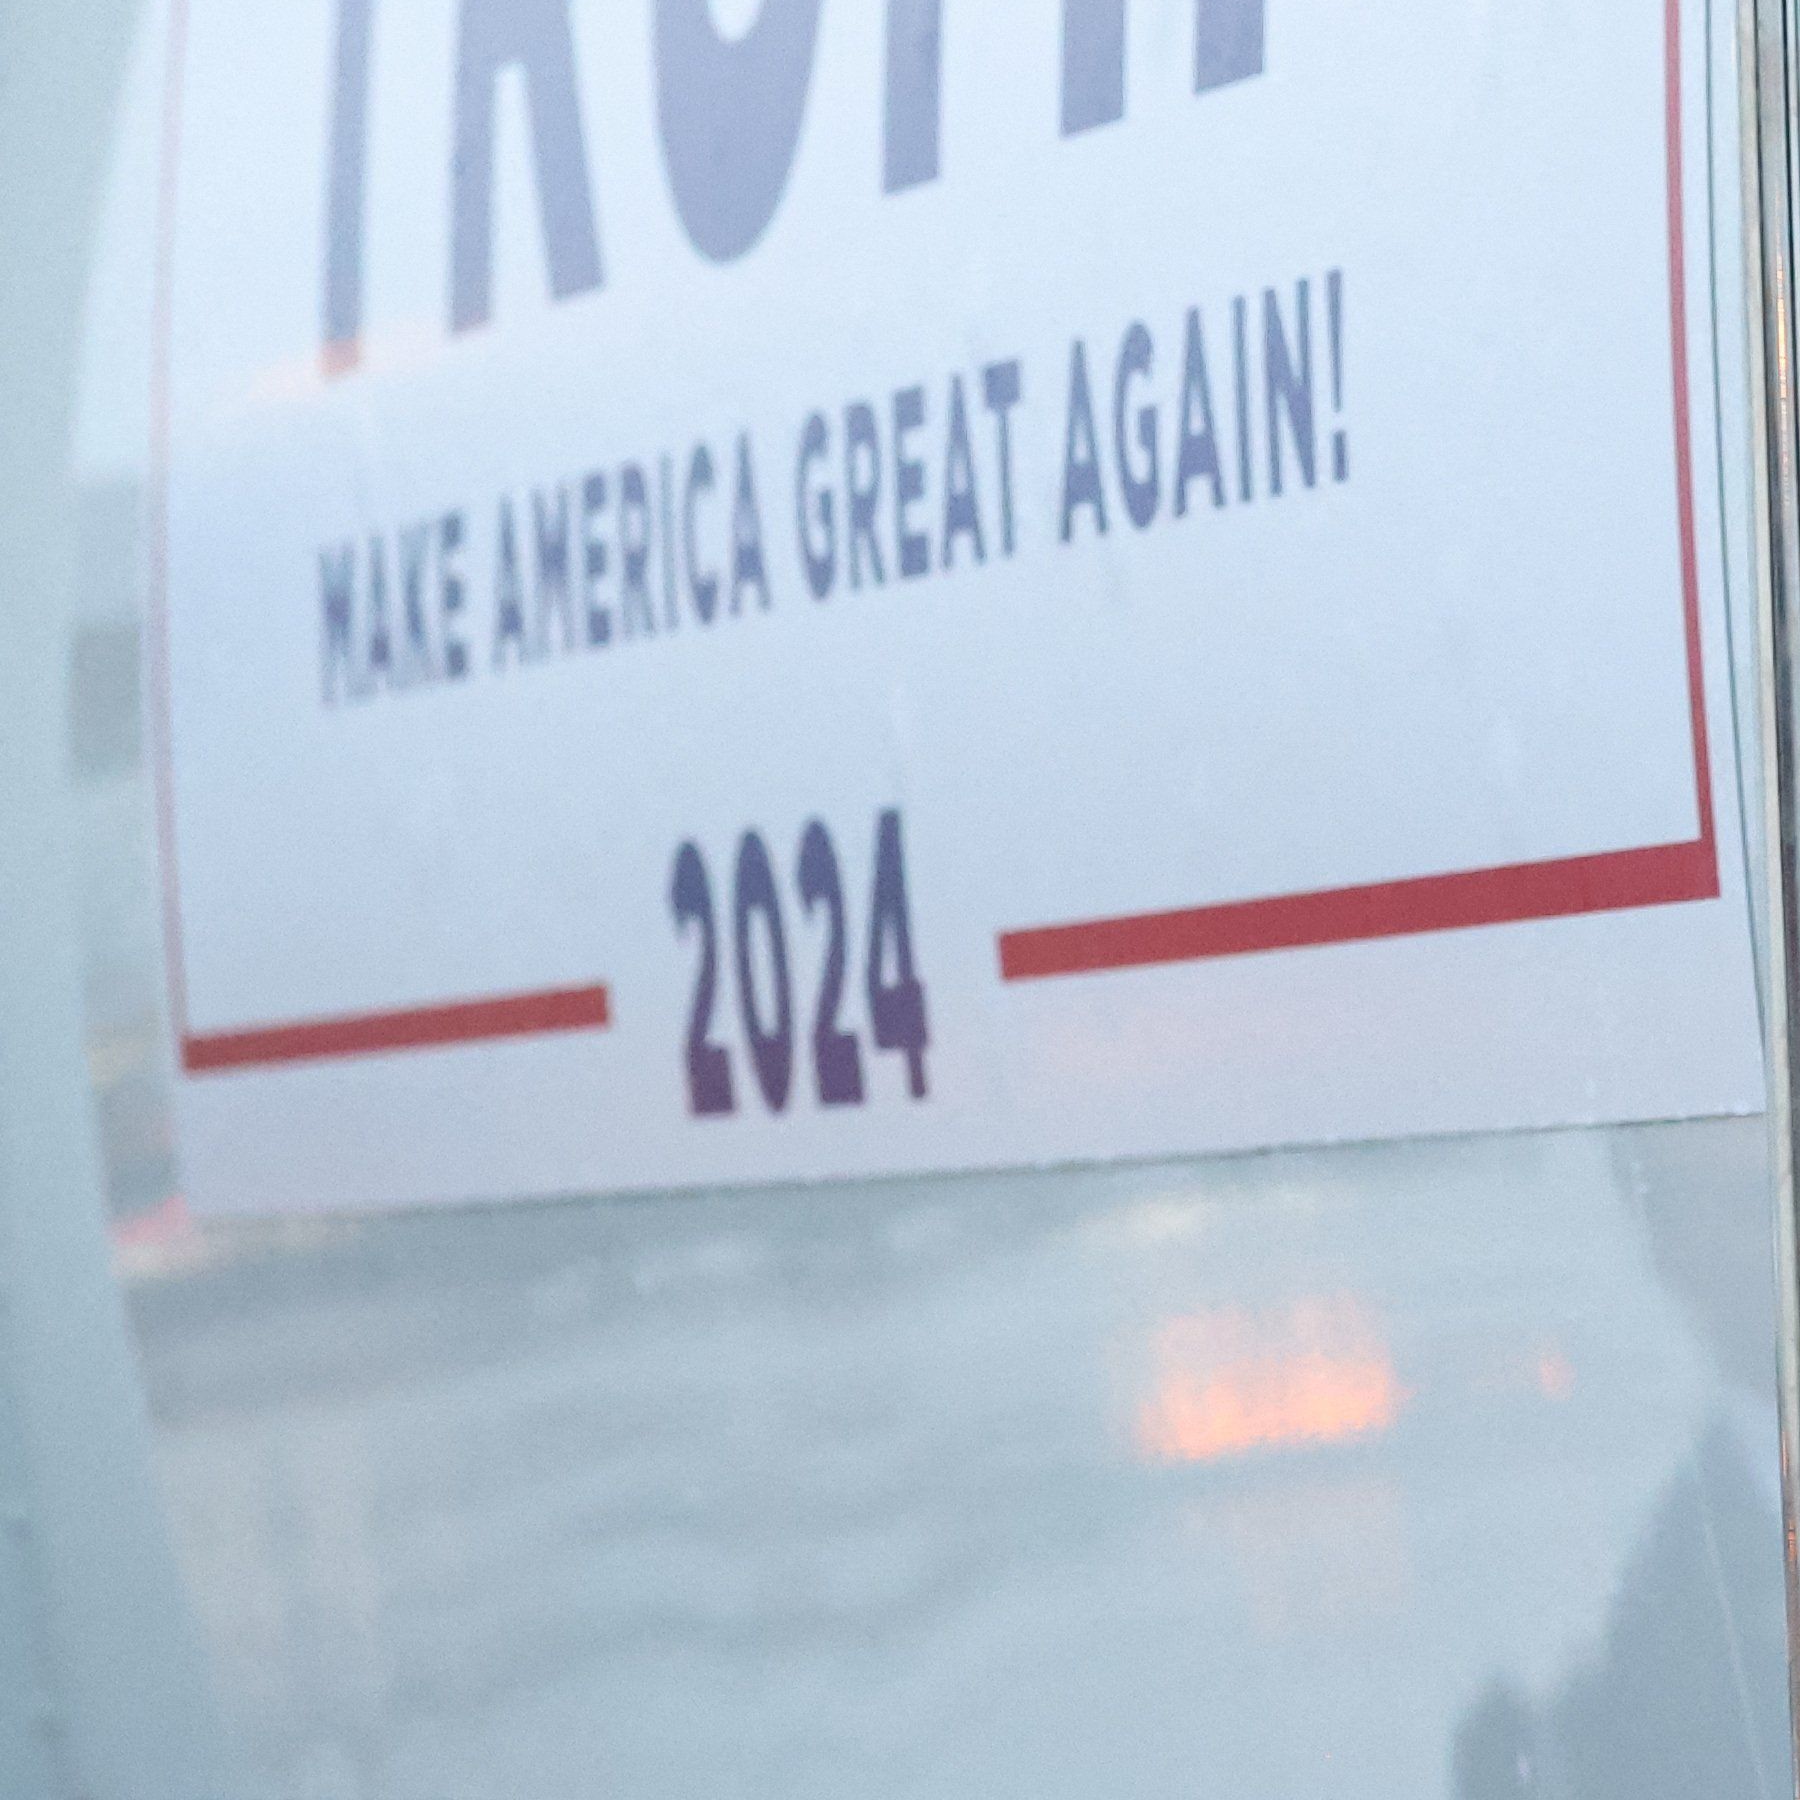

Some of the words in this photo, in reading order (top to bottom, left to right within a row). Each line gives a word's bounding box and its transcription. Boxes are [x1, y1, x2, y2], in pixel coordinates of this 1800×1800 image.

[318, 510, 470, 708] MAKE
[492, 428, 773, 667] AMERICA
[794, 358, 1023, 602] GREAT
[1057, 267, 1351, 545] AGAIN!
[665, 803, 933, 1121] 2024
